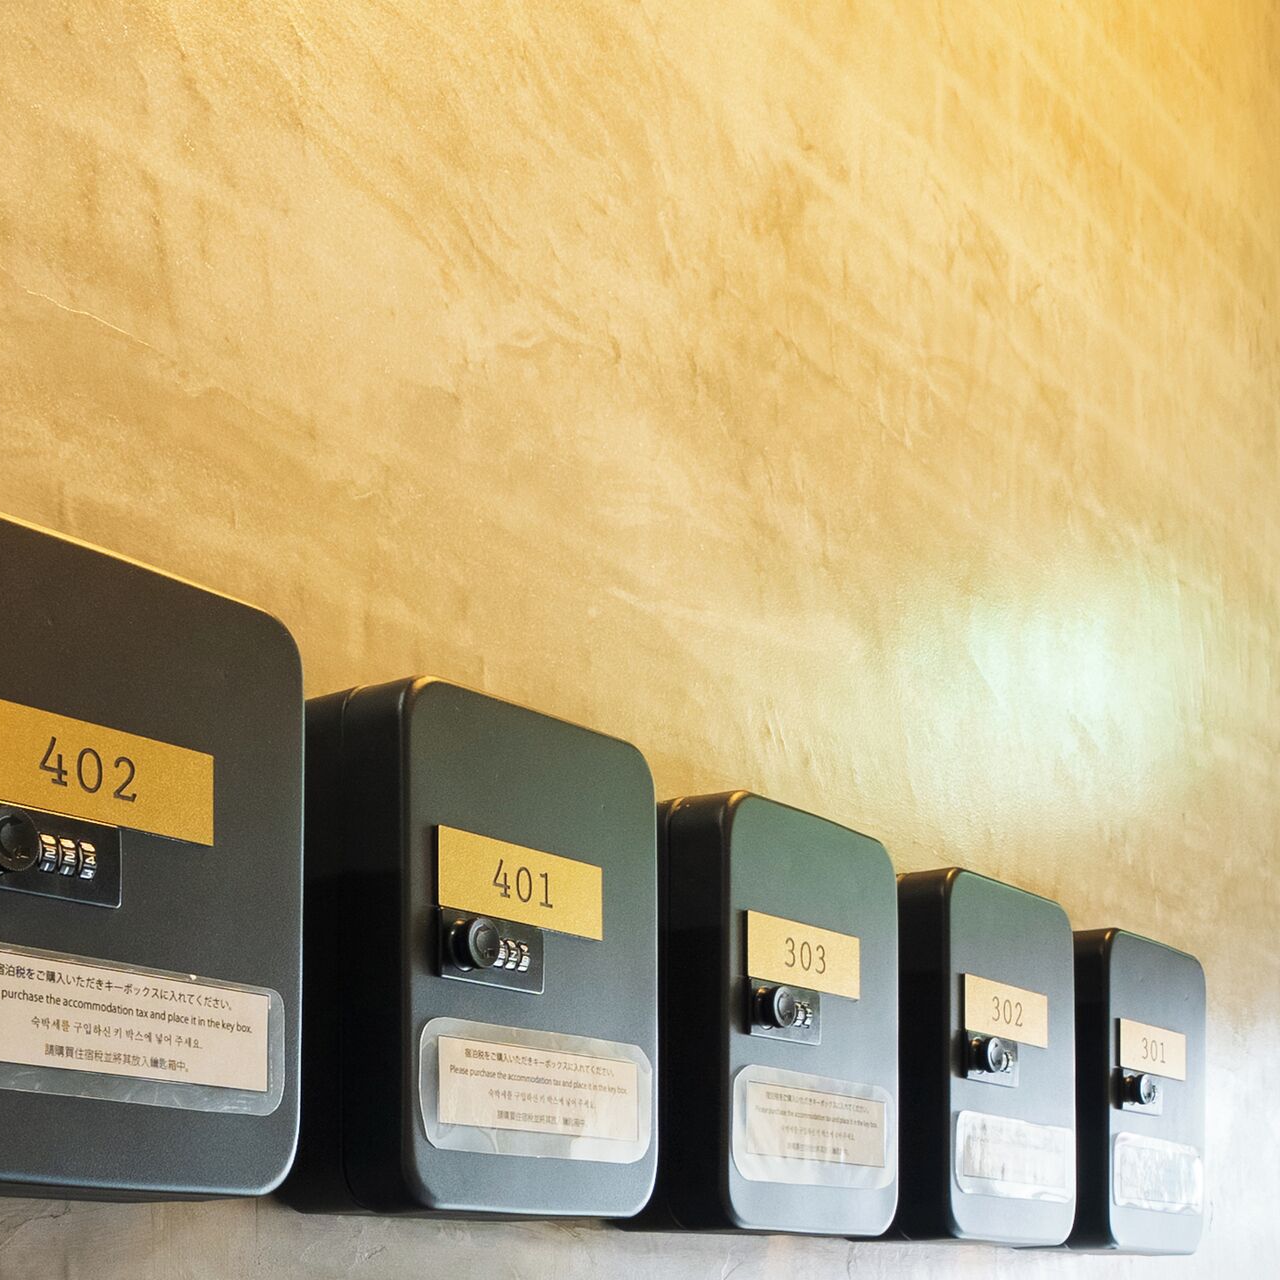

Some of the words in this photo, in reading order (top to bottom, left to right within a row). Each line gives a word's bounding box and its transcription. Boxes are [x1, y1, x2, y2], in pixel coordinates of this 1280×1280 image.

[38, 736, 139, 802] 402
[493, 859, 553, 908] 401
[785, 937, 825, 974] 303
[0, 989, 45, 1004] purchase
[45, 993, 62, 1006] the
[62, 997, 134, 1017] accommodation
[135, 1007, 149, 1019] tax
[149, 1010, 167, 1021] and
[167, 1011, 190, 1025] place
[190, 1015, 197, 1026] it
[197, 1015, 206, 1027] in
[206, 1017, 221, 1030] the
[221, 1019, 236, 1034] key
[235, 1021, 253, 1034] box.
[992, 996, 1023, 1027] 302
[1142, 1037, 1166, 1064] 301
[496, 1070, 508, 1081] the
